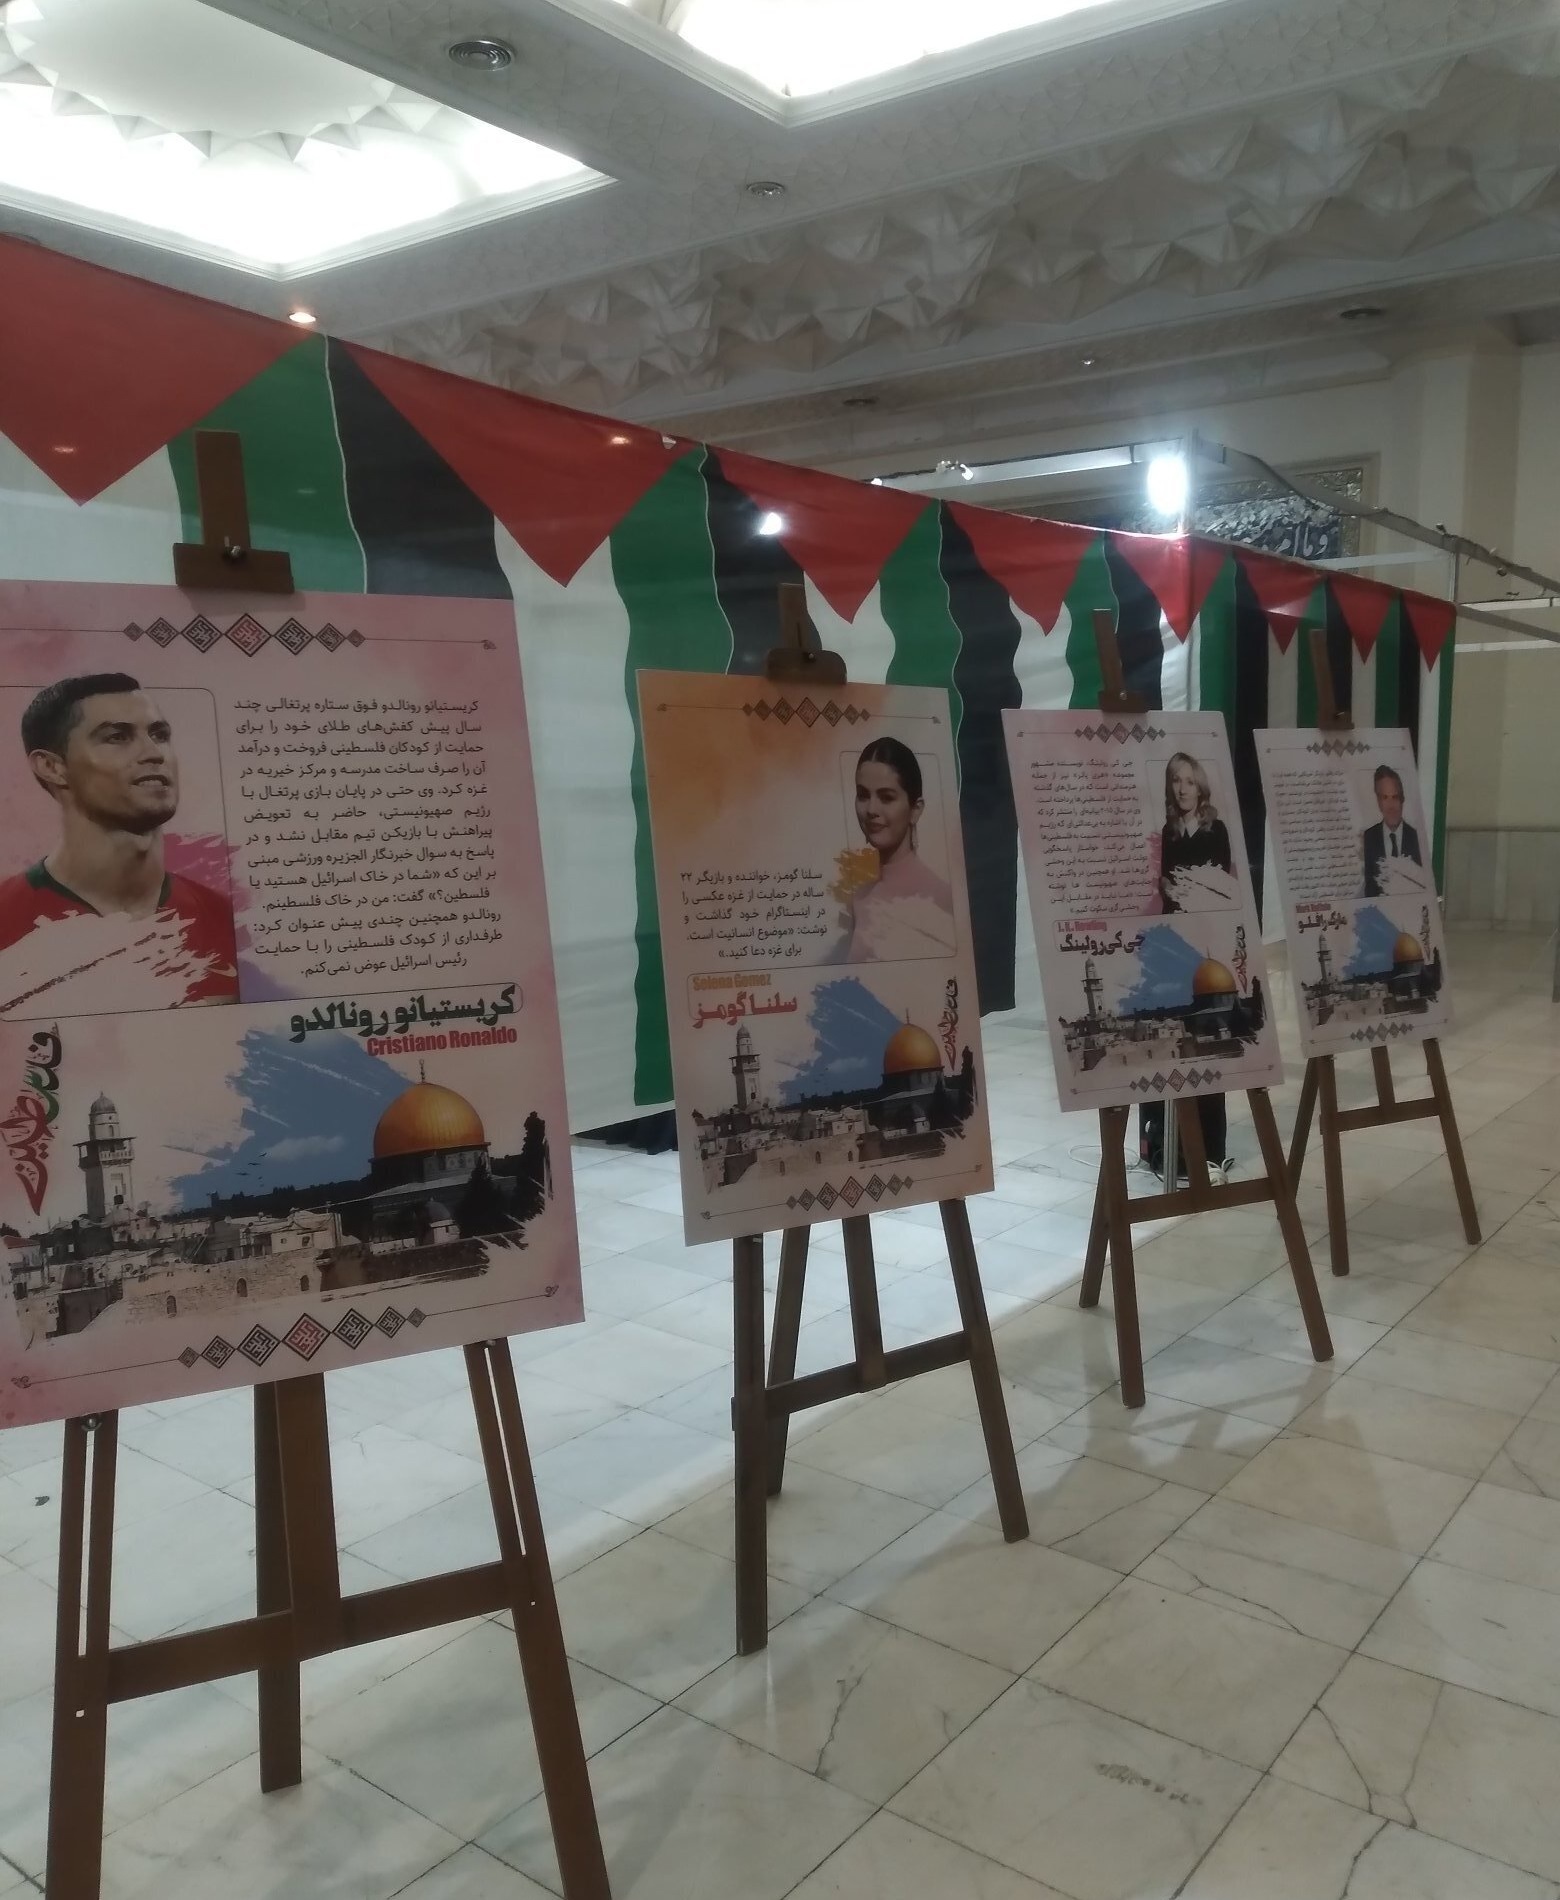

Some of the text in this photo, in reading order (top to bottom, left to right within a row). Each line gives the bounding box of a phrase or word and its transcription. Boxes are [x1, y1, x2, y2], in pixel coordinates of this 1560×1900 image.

[234, 698, 479, 715] کریستیانو رونالدو فوق ستاره پرتغالی چند
[236, 719, 264, 735] برای
[270, 719, 279, 735] را
[284, 721, 312, 735] خود
[317, 720, 351, 735] طلای
[420, 722, 450, 736] پیش
[456, 721, 482, 735] سال
[238, 740, 484, 757] حمایت از کودکان فلسطینی فروخت و درآمد
[240, 761, 486, 779] آن را صرف ساخت مدرسه و مرکز خیریه در
[241, 783, 488, 801] غزه کرد. وی حتی در پایان بازی پرتغال با
[244, 809, 292, 824] تعویض
[304, 810, 320, 821] به
[331, 806, 367, 822] حاضر
[464, 805, 491, 819] رژیم
[245, 824, 493, 846] پیراهنش با بازیکن تیم مقابل نشد و در
[283, 853, 324, 867] ورزشی
[326, 849, 368, 866] الجزیره
[370, 847, 414, 864] خبرنگار
[450, 850, 463, 860] به
[465, 845, 495, 861] پاسخ
[248, 855, 280, 868] مبنی
[311, 871, 357, 888] اسرائیل
[360, 870, 389, 882] خاک
[392, 872, 405, 885] در
[444, 867, 459, 879] که
[462, 866, 482, 882] این
[485, 871, 497, 881] بر
[696, 870, 726, 886] بازیگر
[727, 874, 733, 887] و
[735, 870, 771, 886] خواننده
[801, 868, 823, 880] سلنا
[249, 875, 261, 890] یا
[264, 877, 308, 889] هستید
[262, 894, 322, 913] فلسطینم.
[323, 893, 353, 906] خاک
[355, 896, 369, 909] در
[370, 897, 390, 908] من
[393, 889, 425, 903] گفت:
[682, 886, 825, 906] ساله در حمایت از غزه عکسی را
[254, 908, 502, 935] رونالدو همچنین چندی پیش عنوان کرد:
[684, 914, 690, 925] و
[695, 907, 733, 921] گذاشت
[740, 908, 760, 925] خود
[816, 908, 826, 919] در
[255, 928, 503, 957] طرفداری از کودک فلسطینی را با حمایت
[716, 926, 756, 944] انسانیت
[750, 944, 767, 959] دعا
[767, 943, 784, 959] غزه
[784, 942, 803, 959] برای
[354, 959, 388, 975] عوض
[390, 954, 432, 974] اسرائیل
[435, 952, 468, 969] رئیس
[289, 984, 516, 1043] کریستیانو رونالدو
[692, 991, 798, 1028] سلنا گومز
[367, 1026, 518, 1057] Cristiano Ronaldo
